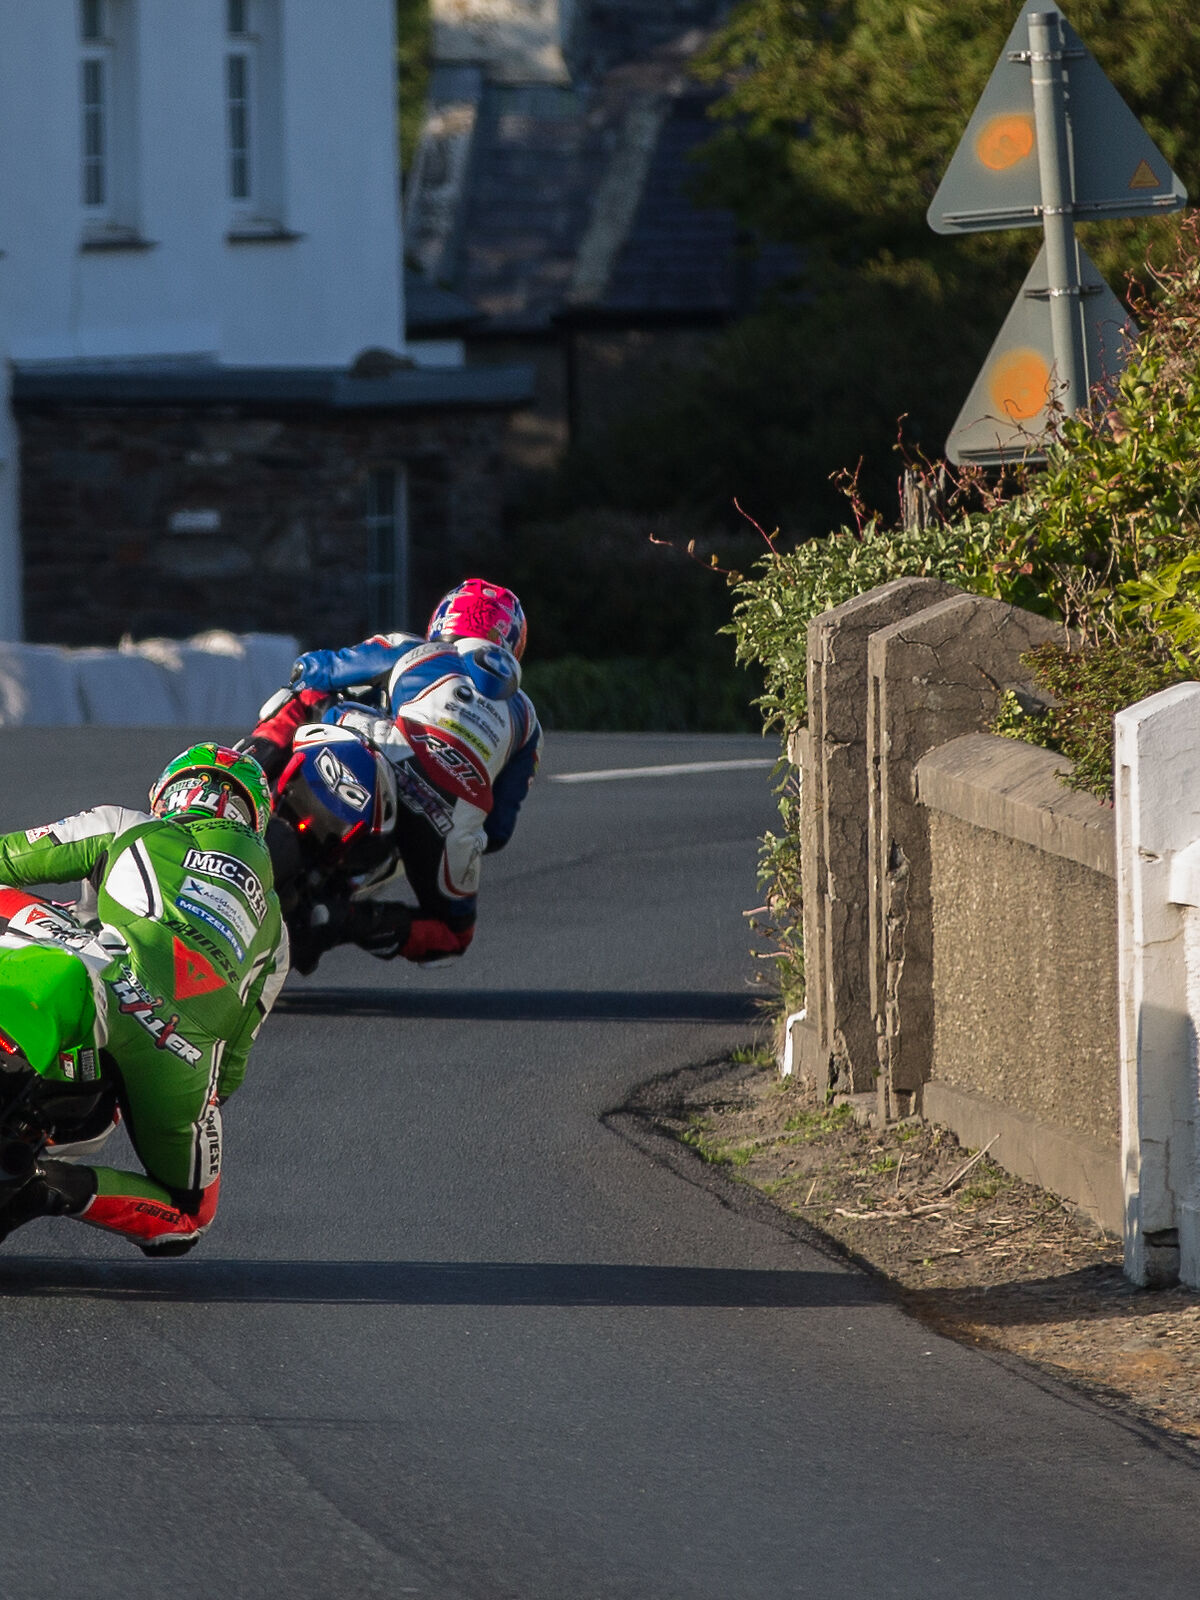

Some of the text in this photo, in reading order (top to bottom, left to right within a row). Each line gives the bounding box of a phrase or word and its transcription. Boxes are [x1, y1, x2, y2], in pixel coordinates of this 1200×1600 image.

[411, 733, 486, 785] RST
[180, 899, 239, 949] METZELER
[165, 920, 240, 984] DAINESE
